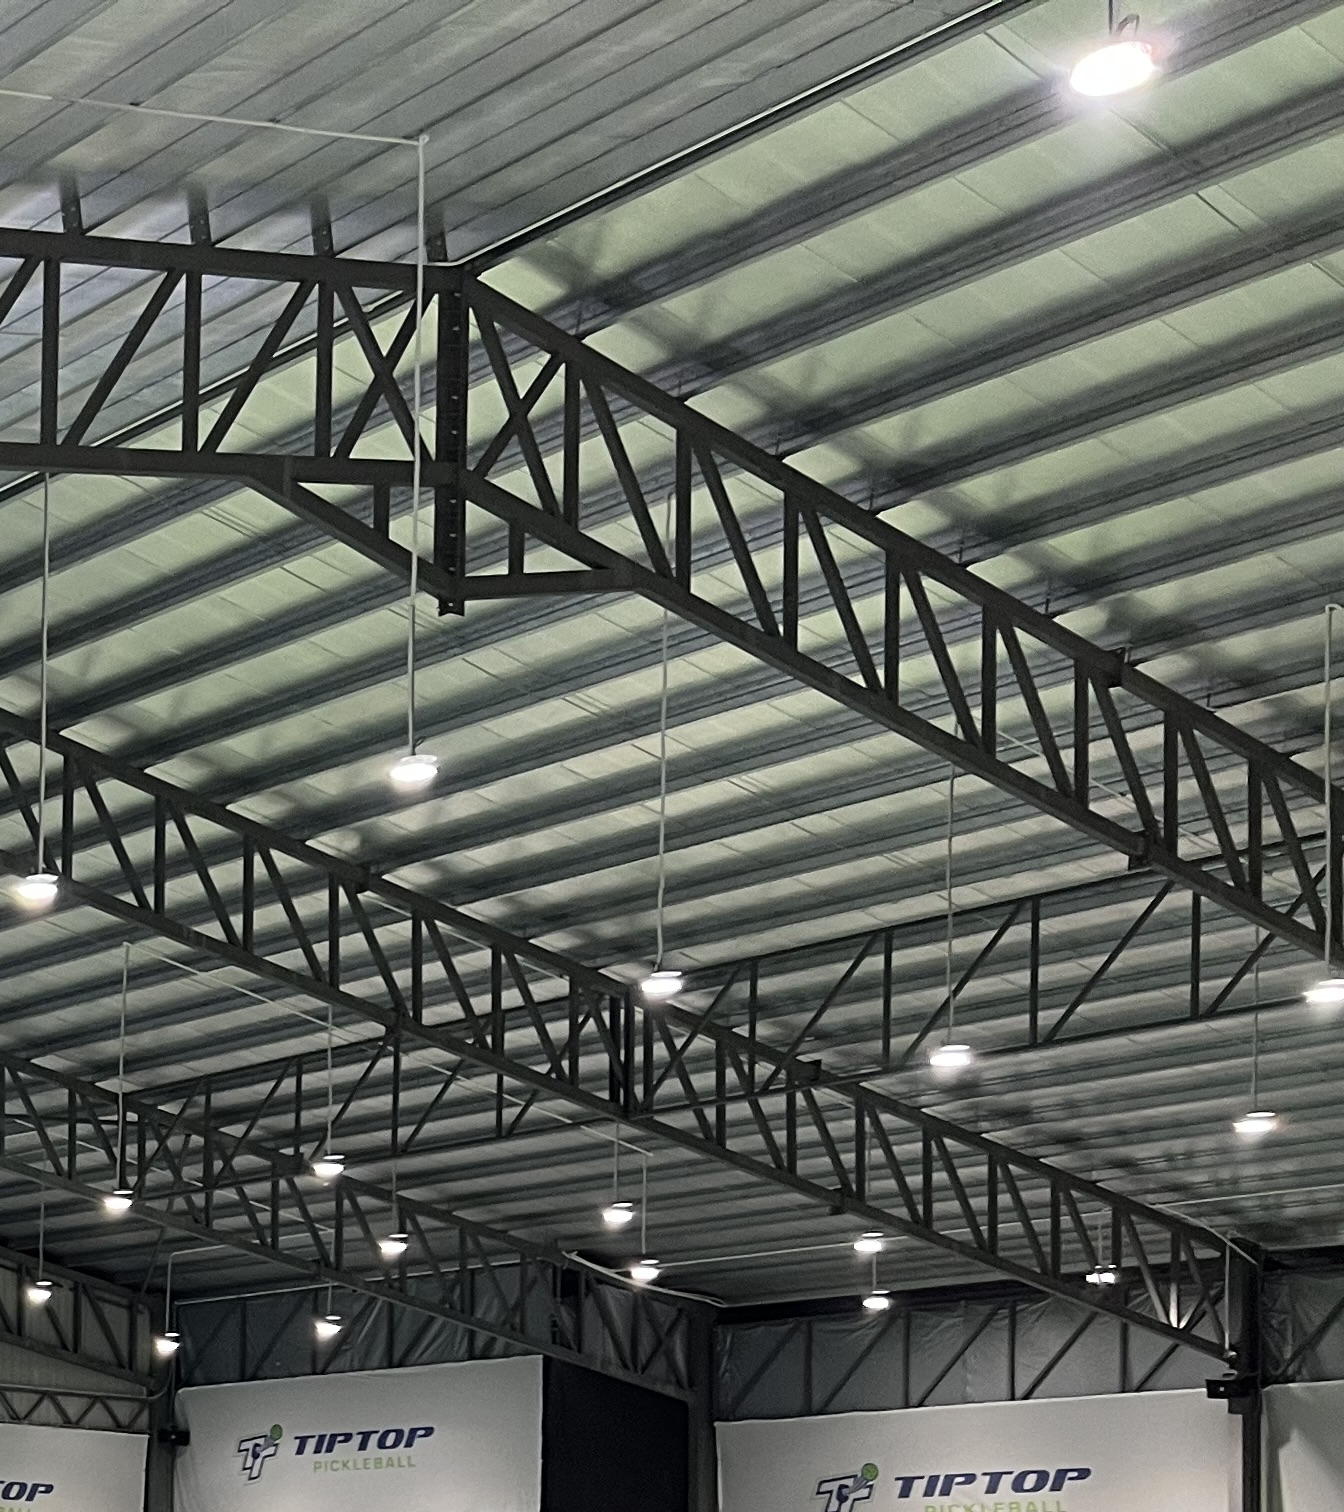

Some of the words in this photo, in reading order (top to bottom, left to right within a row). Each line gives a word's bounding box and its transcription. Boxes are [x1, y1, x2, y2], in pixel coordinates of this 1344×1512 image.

[293, 1426, 436, 1456] TIPTOP
[313, 1455, 417, 1473] PICKLEBALL
[894, 1467, 1092, 1499] TIPTOP
